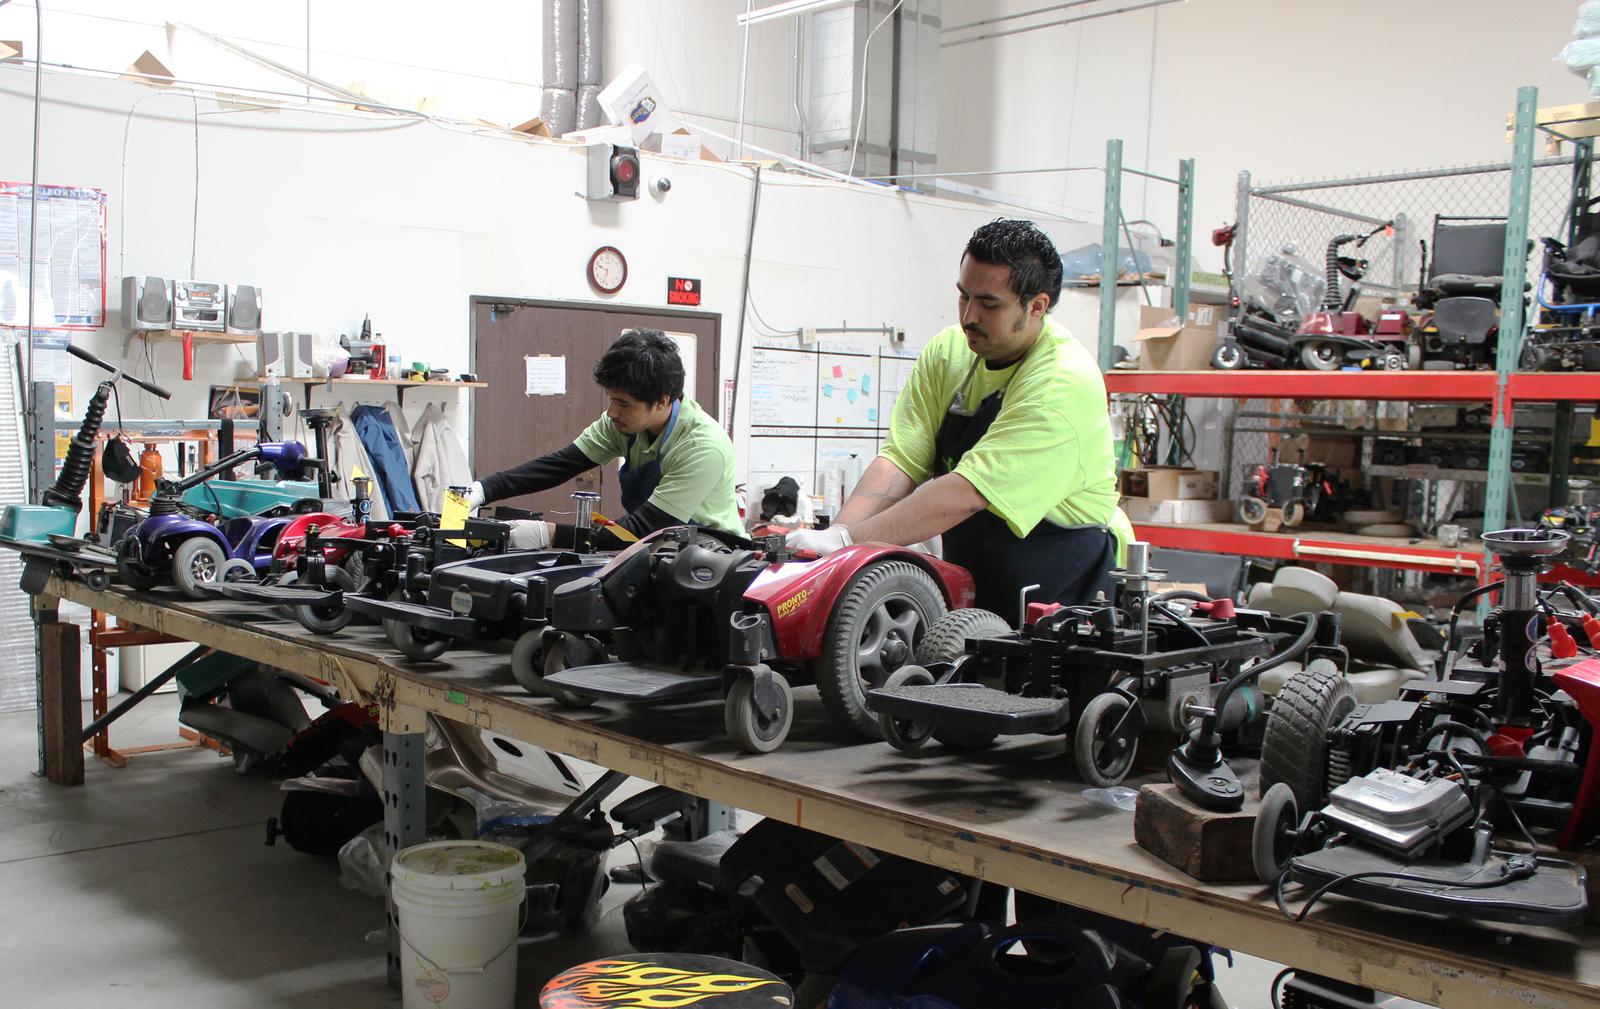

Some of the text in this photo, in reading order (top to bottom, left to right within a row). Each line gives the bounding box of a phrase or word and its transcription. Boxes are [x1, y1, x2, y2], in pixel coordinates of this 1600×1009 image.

[675, 279, 693, 291] NO
[669, 290, 699, 304] SMOKING
[777, 589, 807, 614] PRONTO
